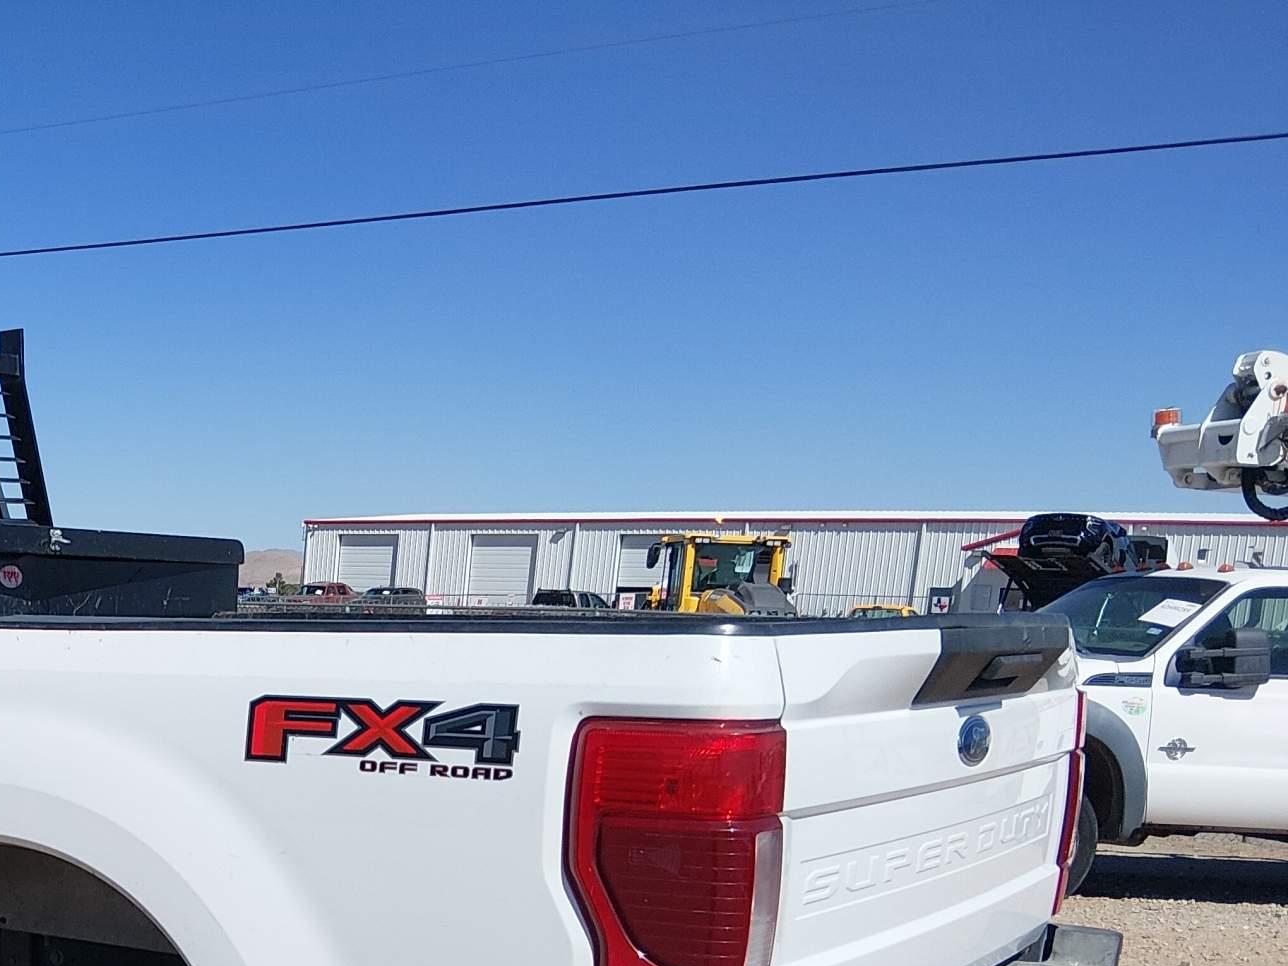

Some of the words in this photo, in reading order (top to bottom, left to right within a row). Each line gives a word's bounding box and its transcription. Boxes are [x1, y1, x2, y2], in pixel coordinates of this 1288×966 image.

[244, 694, 520, 766] FX4
[359, 759, 418, 775] OFF
[429, 763, 513, 781] ROAD
[801, 831, 969, 906] SUPER
[976, 801, 1050, 854] DUTY
